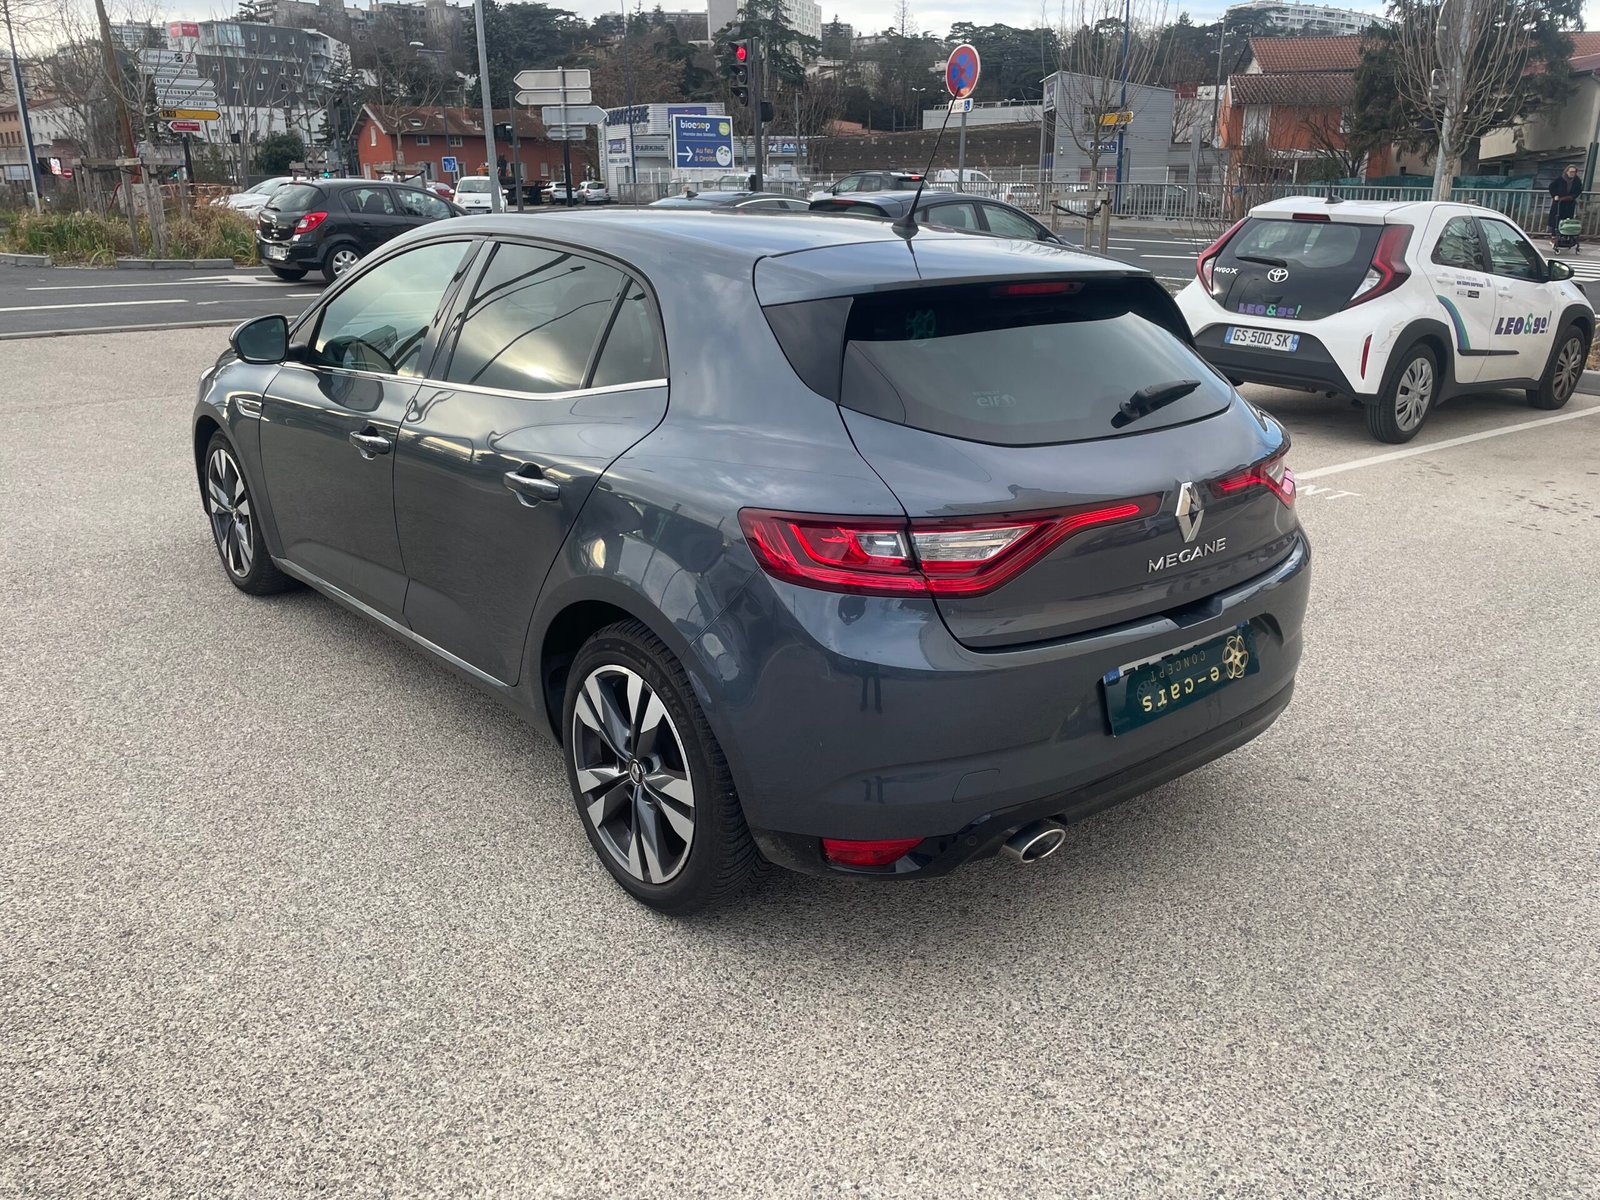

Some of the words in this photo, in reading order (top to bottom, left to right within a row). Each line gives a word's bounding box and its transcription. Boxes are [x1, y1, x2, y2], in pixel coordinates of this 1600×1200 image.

[680, 119, 710, 131] biocoop
[1238, 303, 1302, 318] LEO&go!
[1494, 310, 1552, 335] LEO&go!
[1233, 328, 1291, 348] GS-500-SK
[1147, 537, 1227, 573] MEGANE
[1150, 650, 1206, 683] CONCEPT
[1142, 665, 1221, 713] e-cars
